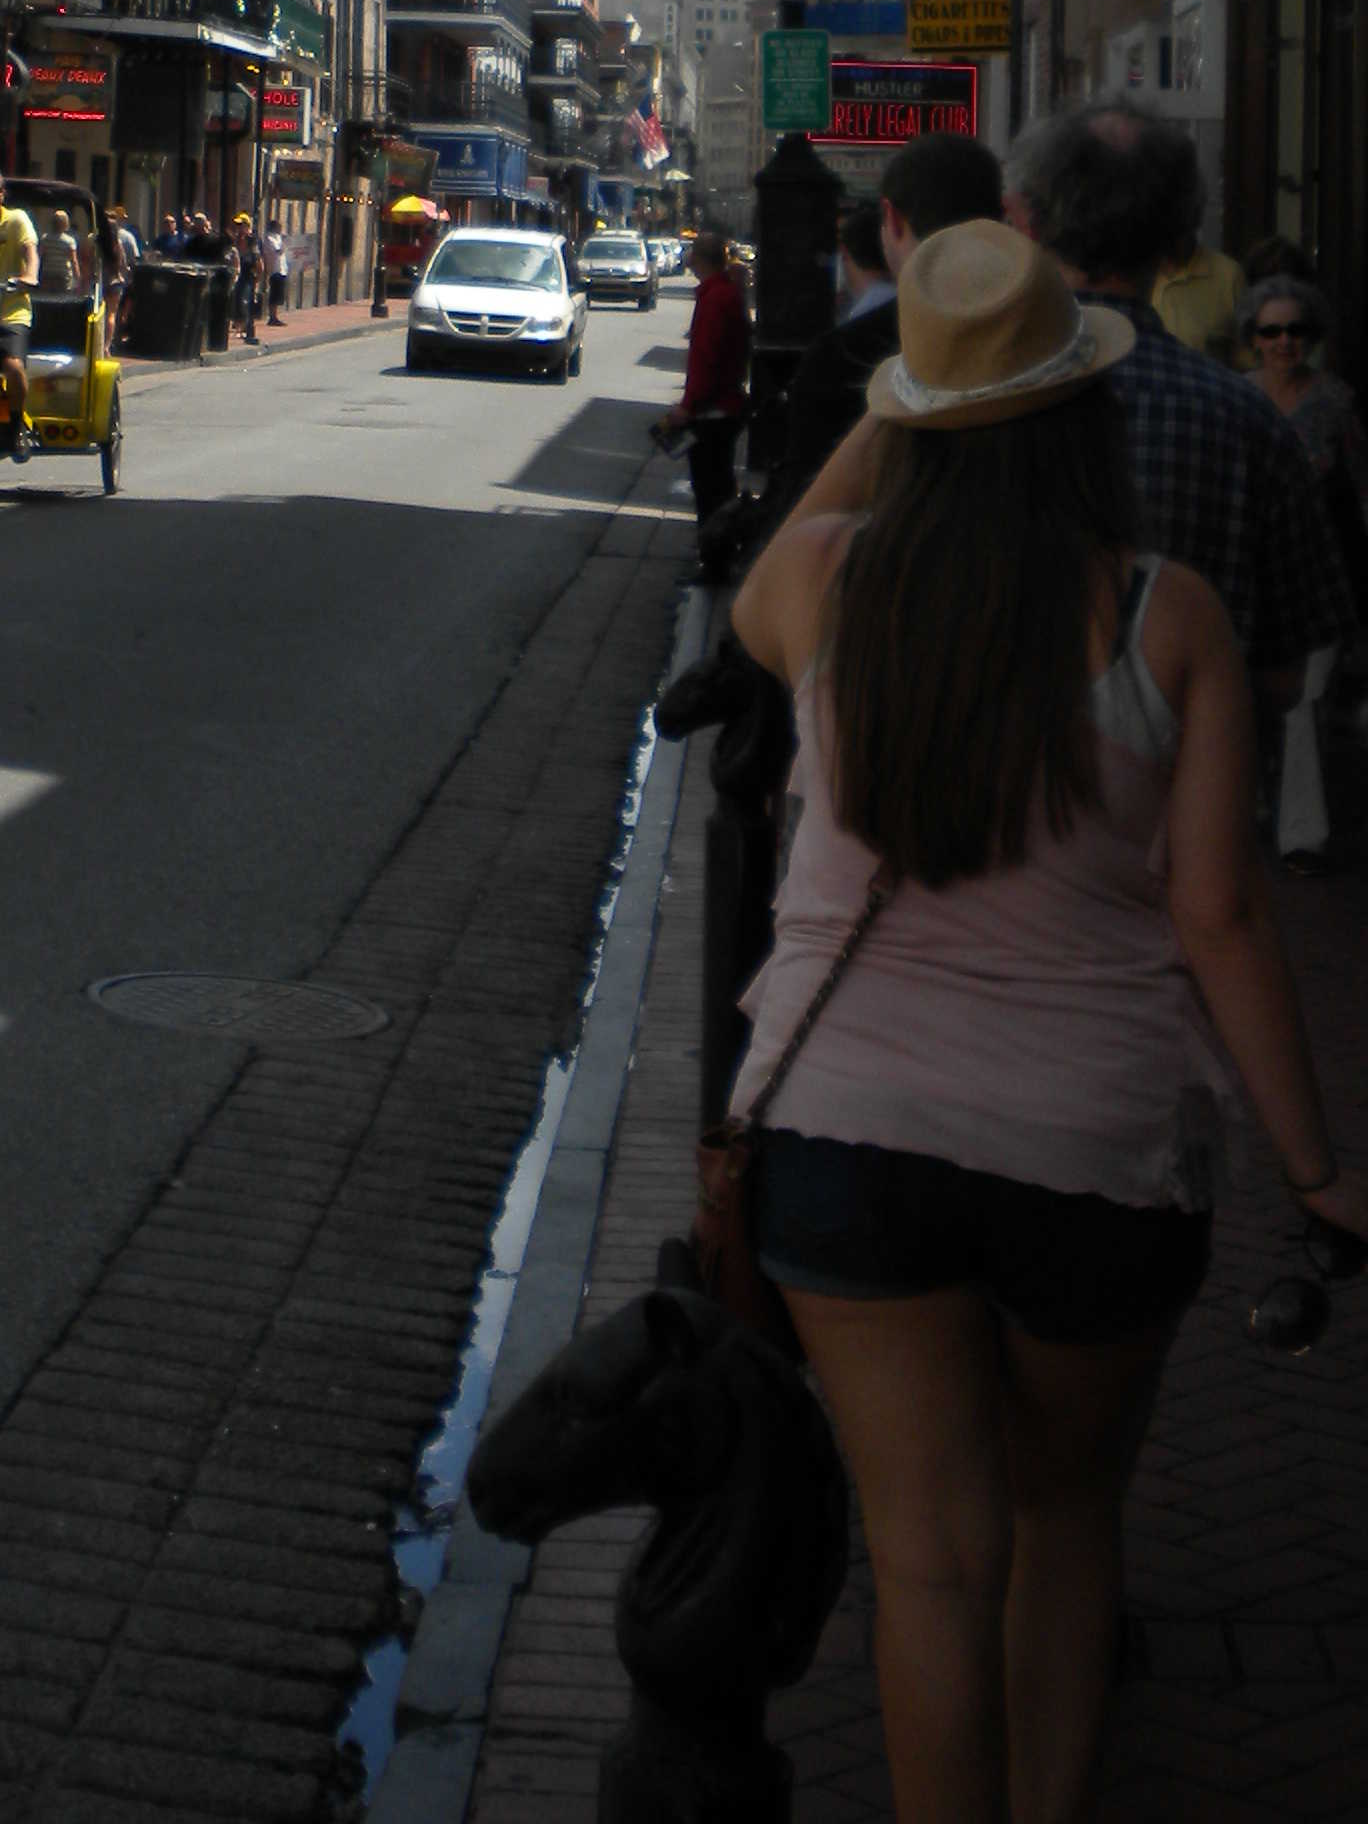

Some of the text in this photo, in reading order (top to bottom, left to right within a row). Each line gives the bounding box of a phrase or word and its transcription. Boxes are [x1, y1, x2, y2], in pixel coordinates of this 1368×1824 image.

[854, 80, 922, 97] HUSTLER
[833, 102, 874, 138] RELY
[876, 103, 921, 138] LEGAL
